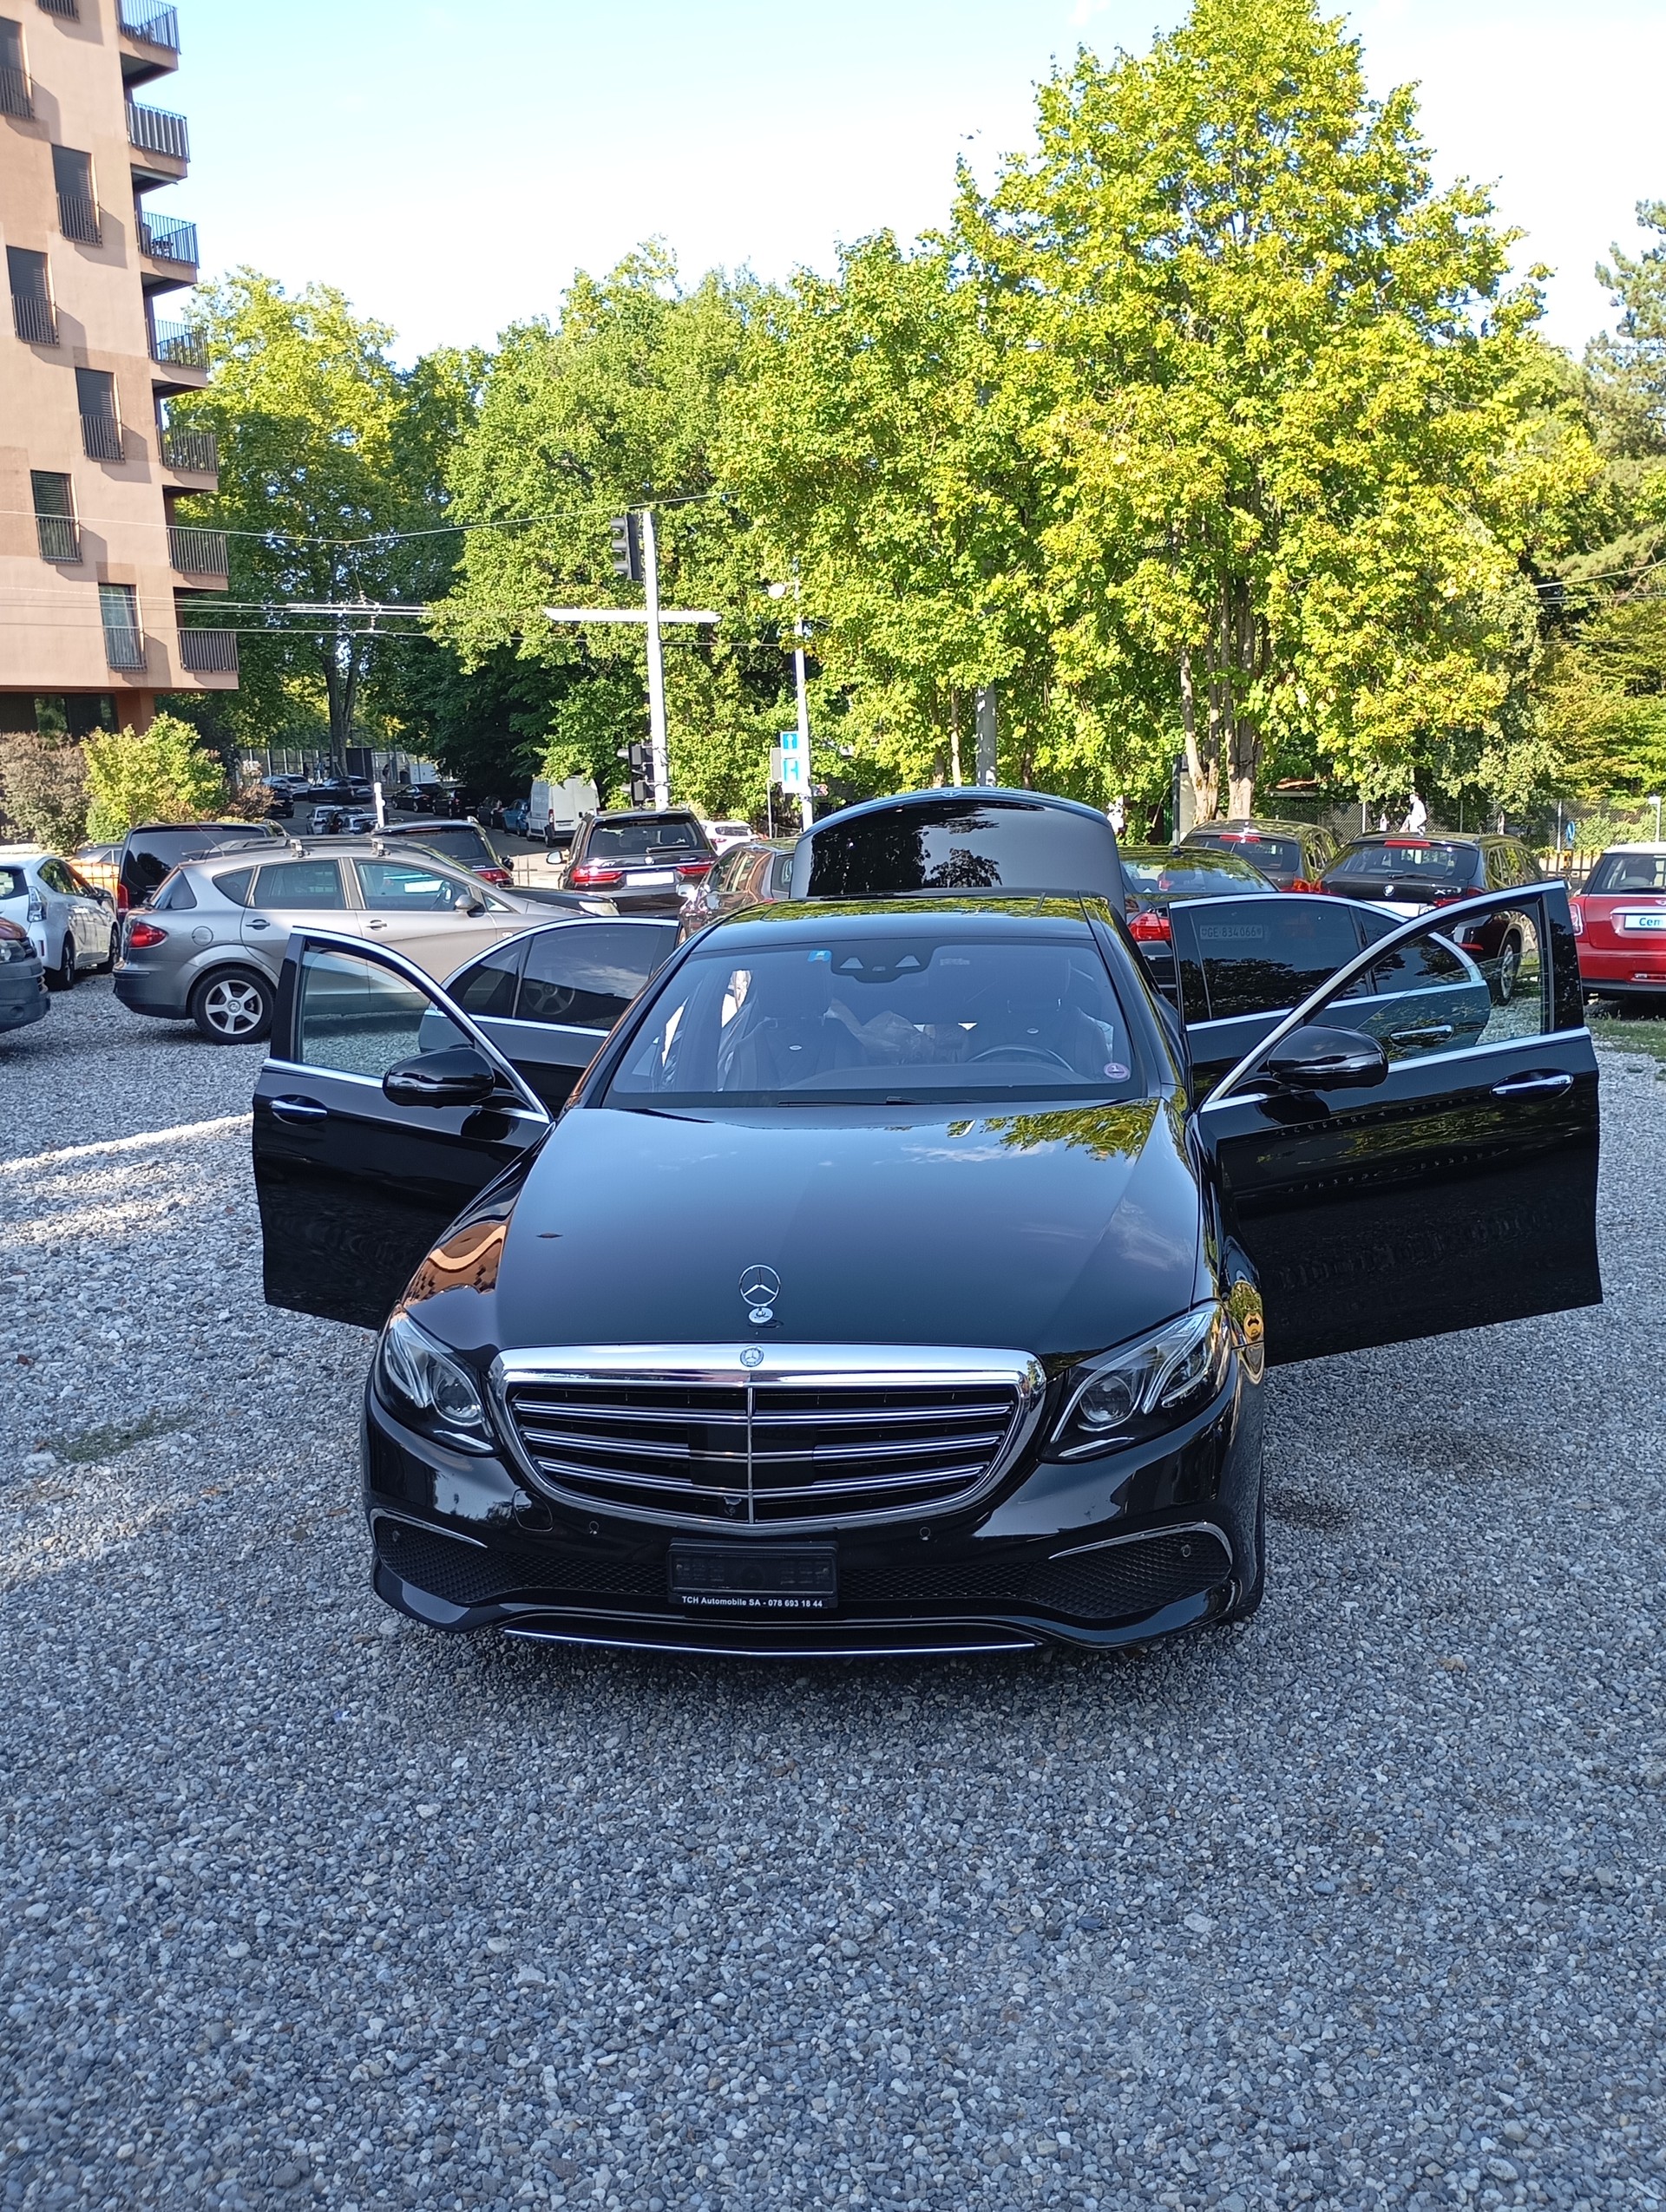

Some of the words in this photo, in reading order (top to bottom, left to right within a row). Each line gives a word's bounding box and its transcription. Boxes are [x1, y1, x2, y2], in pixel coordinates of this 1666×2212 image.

[700, 1597, 747, 1606] Automobile
[748, 1598, 761, 1607] SA
[784, 1599, 799, 1607] 693
